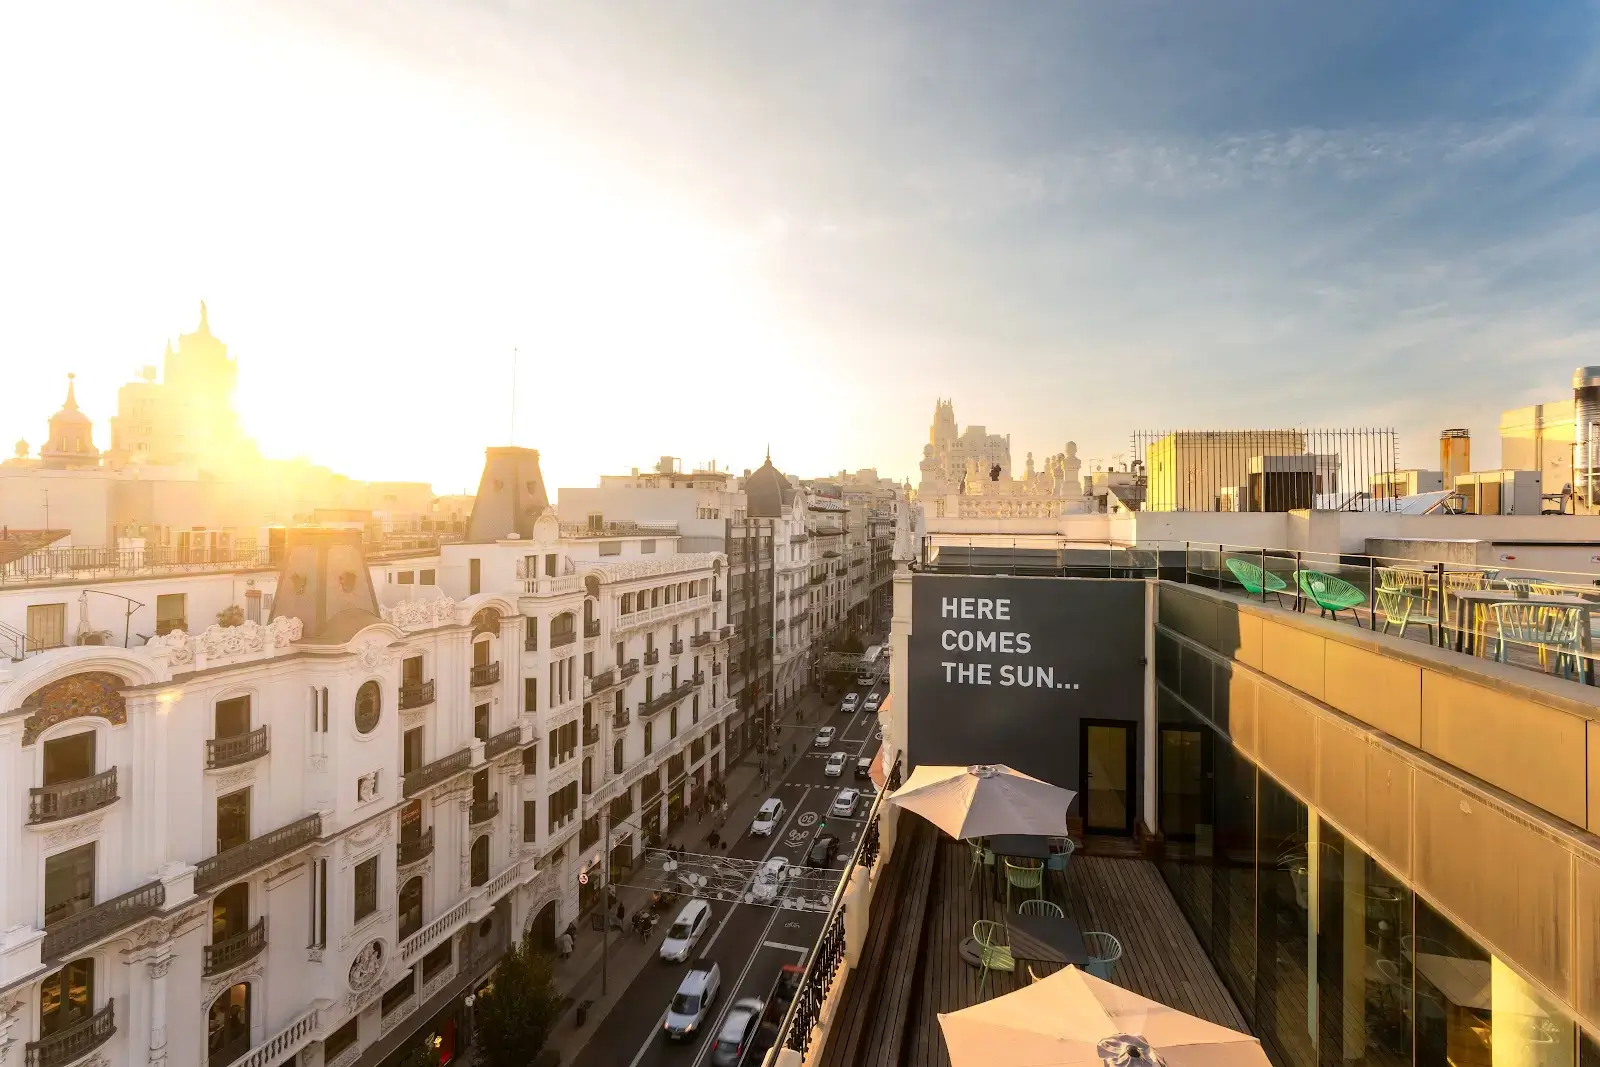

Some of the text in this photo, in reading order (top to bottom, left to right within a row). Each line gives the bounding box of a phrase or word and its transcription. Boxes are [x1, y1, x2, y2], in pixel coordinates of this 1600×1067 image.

[941, 596, 1011, 620] HERE
[941, 629, 1032, 654] COMES
[941, 661, 1079, 690] THE SUN...
